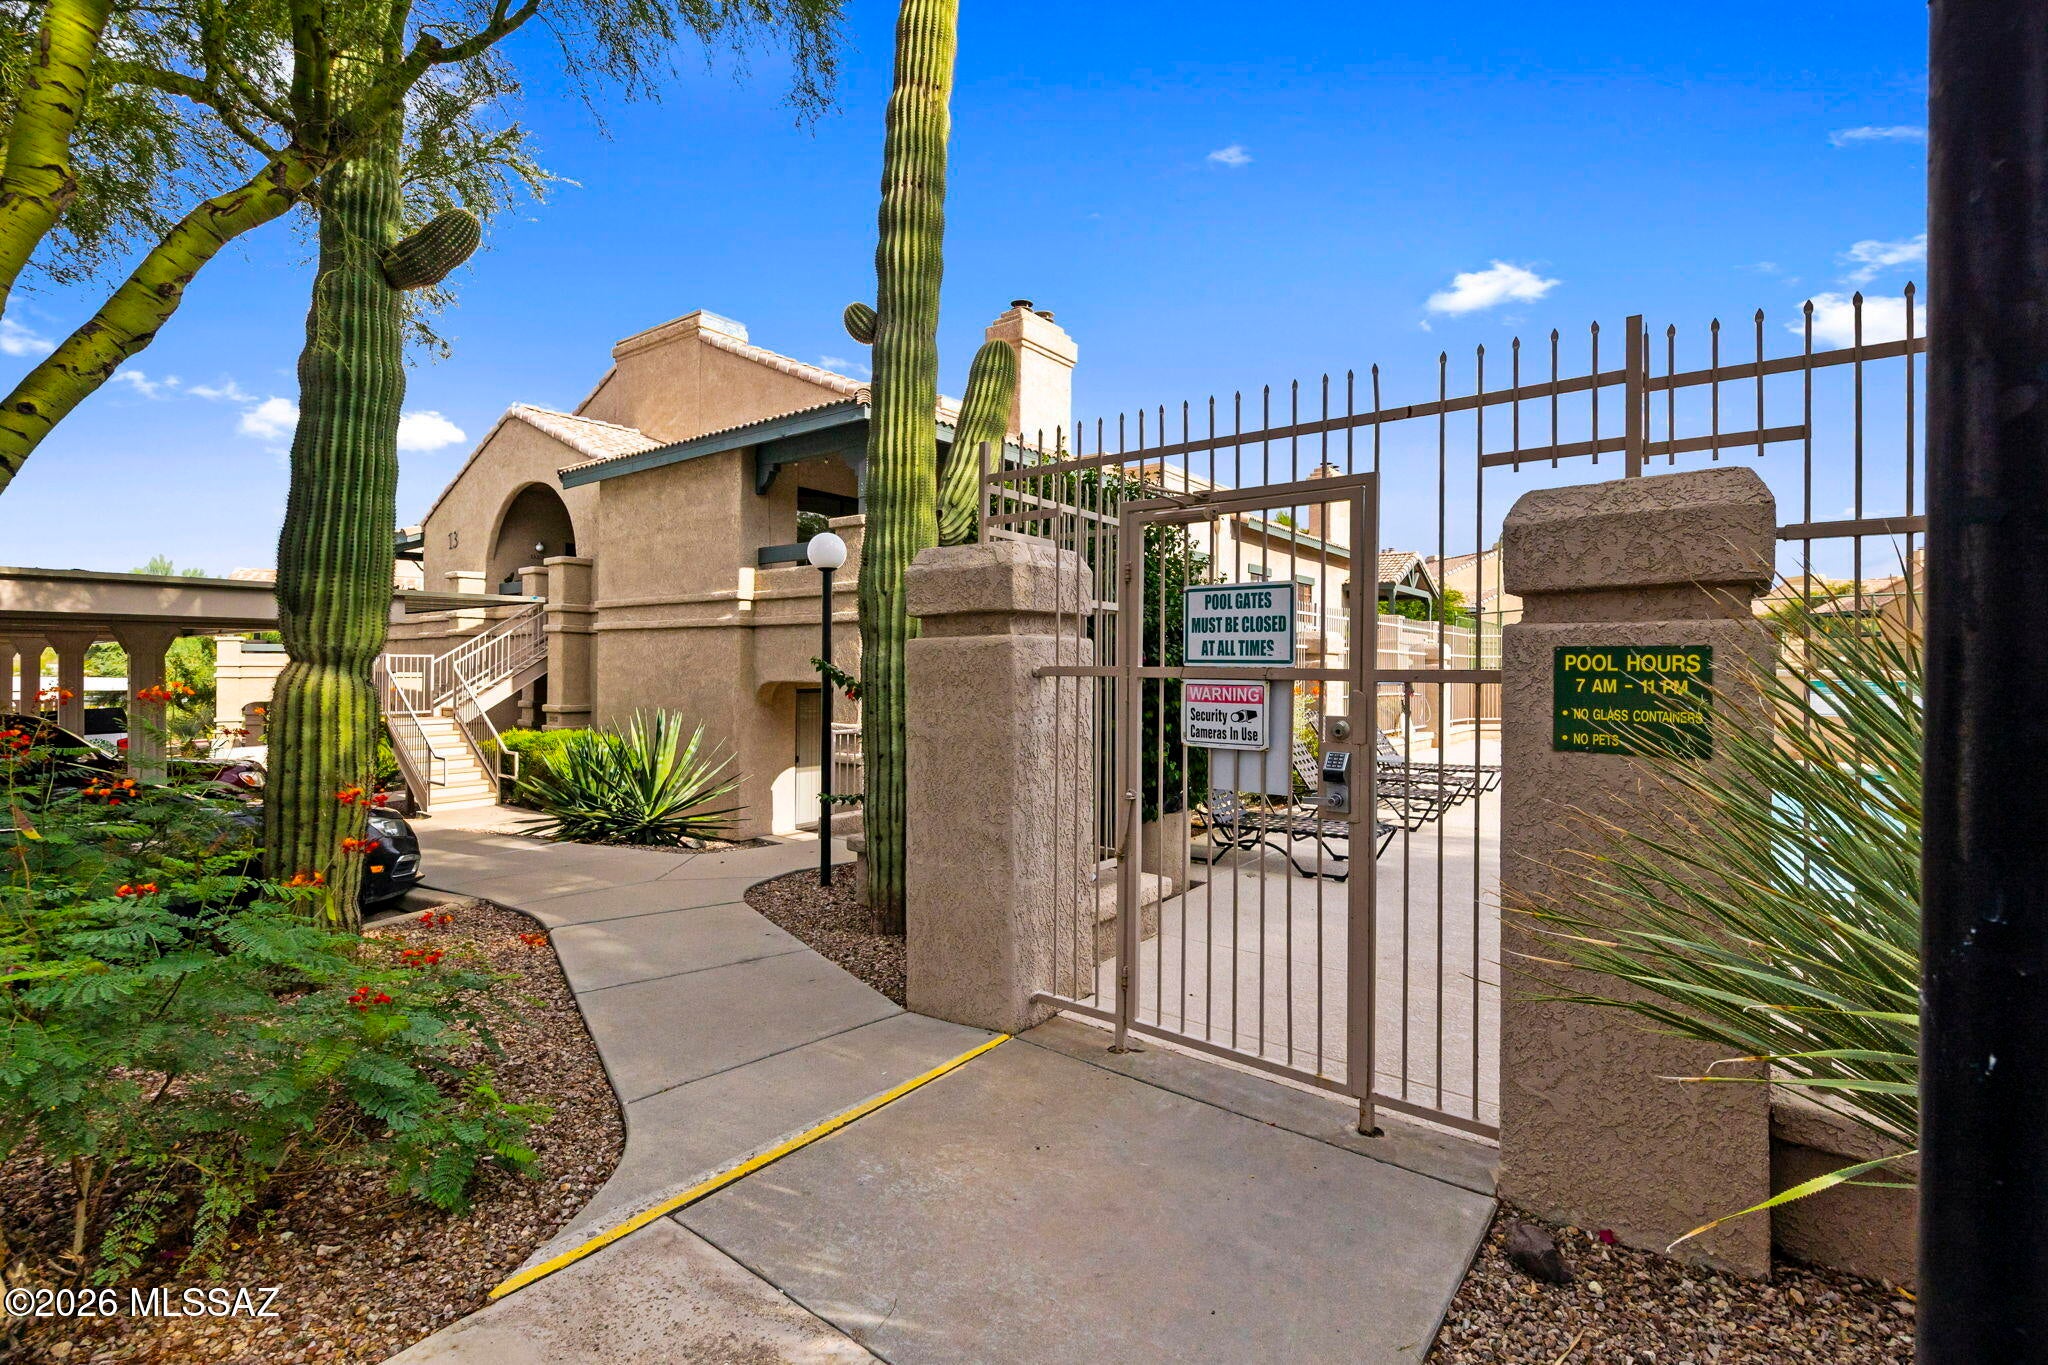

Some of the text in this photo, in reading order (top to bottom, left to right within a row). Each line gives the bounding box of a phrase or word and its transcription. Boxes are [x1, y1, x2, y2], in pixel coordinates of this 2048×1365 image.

[1205, 592, 1272, 610] POOL GATES
[1191, 615, 1287, 634] MUST BE CLOSED
[1201, 639, 1275, 656] AT ALL TIMES
[1564, 654, 1701, 673] POOL HOURS
[1189, 686, 1261, 702] WARNING
[1575, 679, 1586, 693] 7
[1591, 679, 1617, 693] AM
[1641, 679, 1656, 694] 11
[1662, 679, 1689, 695] PM
[1190, 707, 1228, 725] Security
[1573, 708, 1703, 724] NO GLASS CONTAINERS
[1190, 725, 1259, 742] Cameras In Use
[1573, 733, 1620, 747] NO PETS
